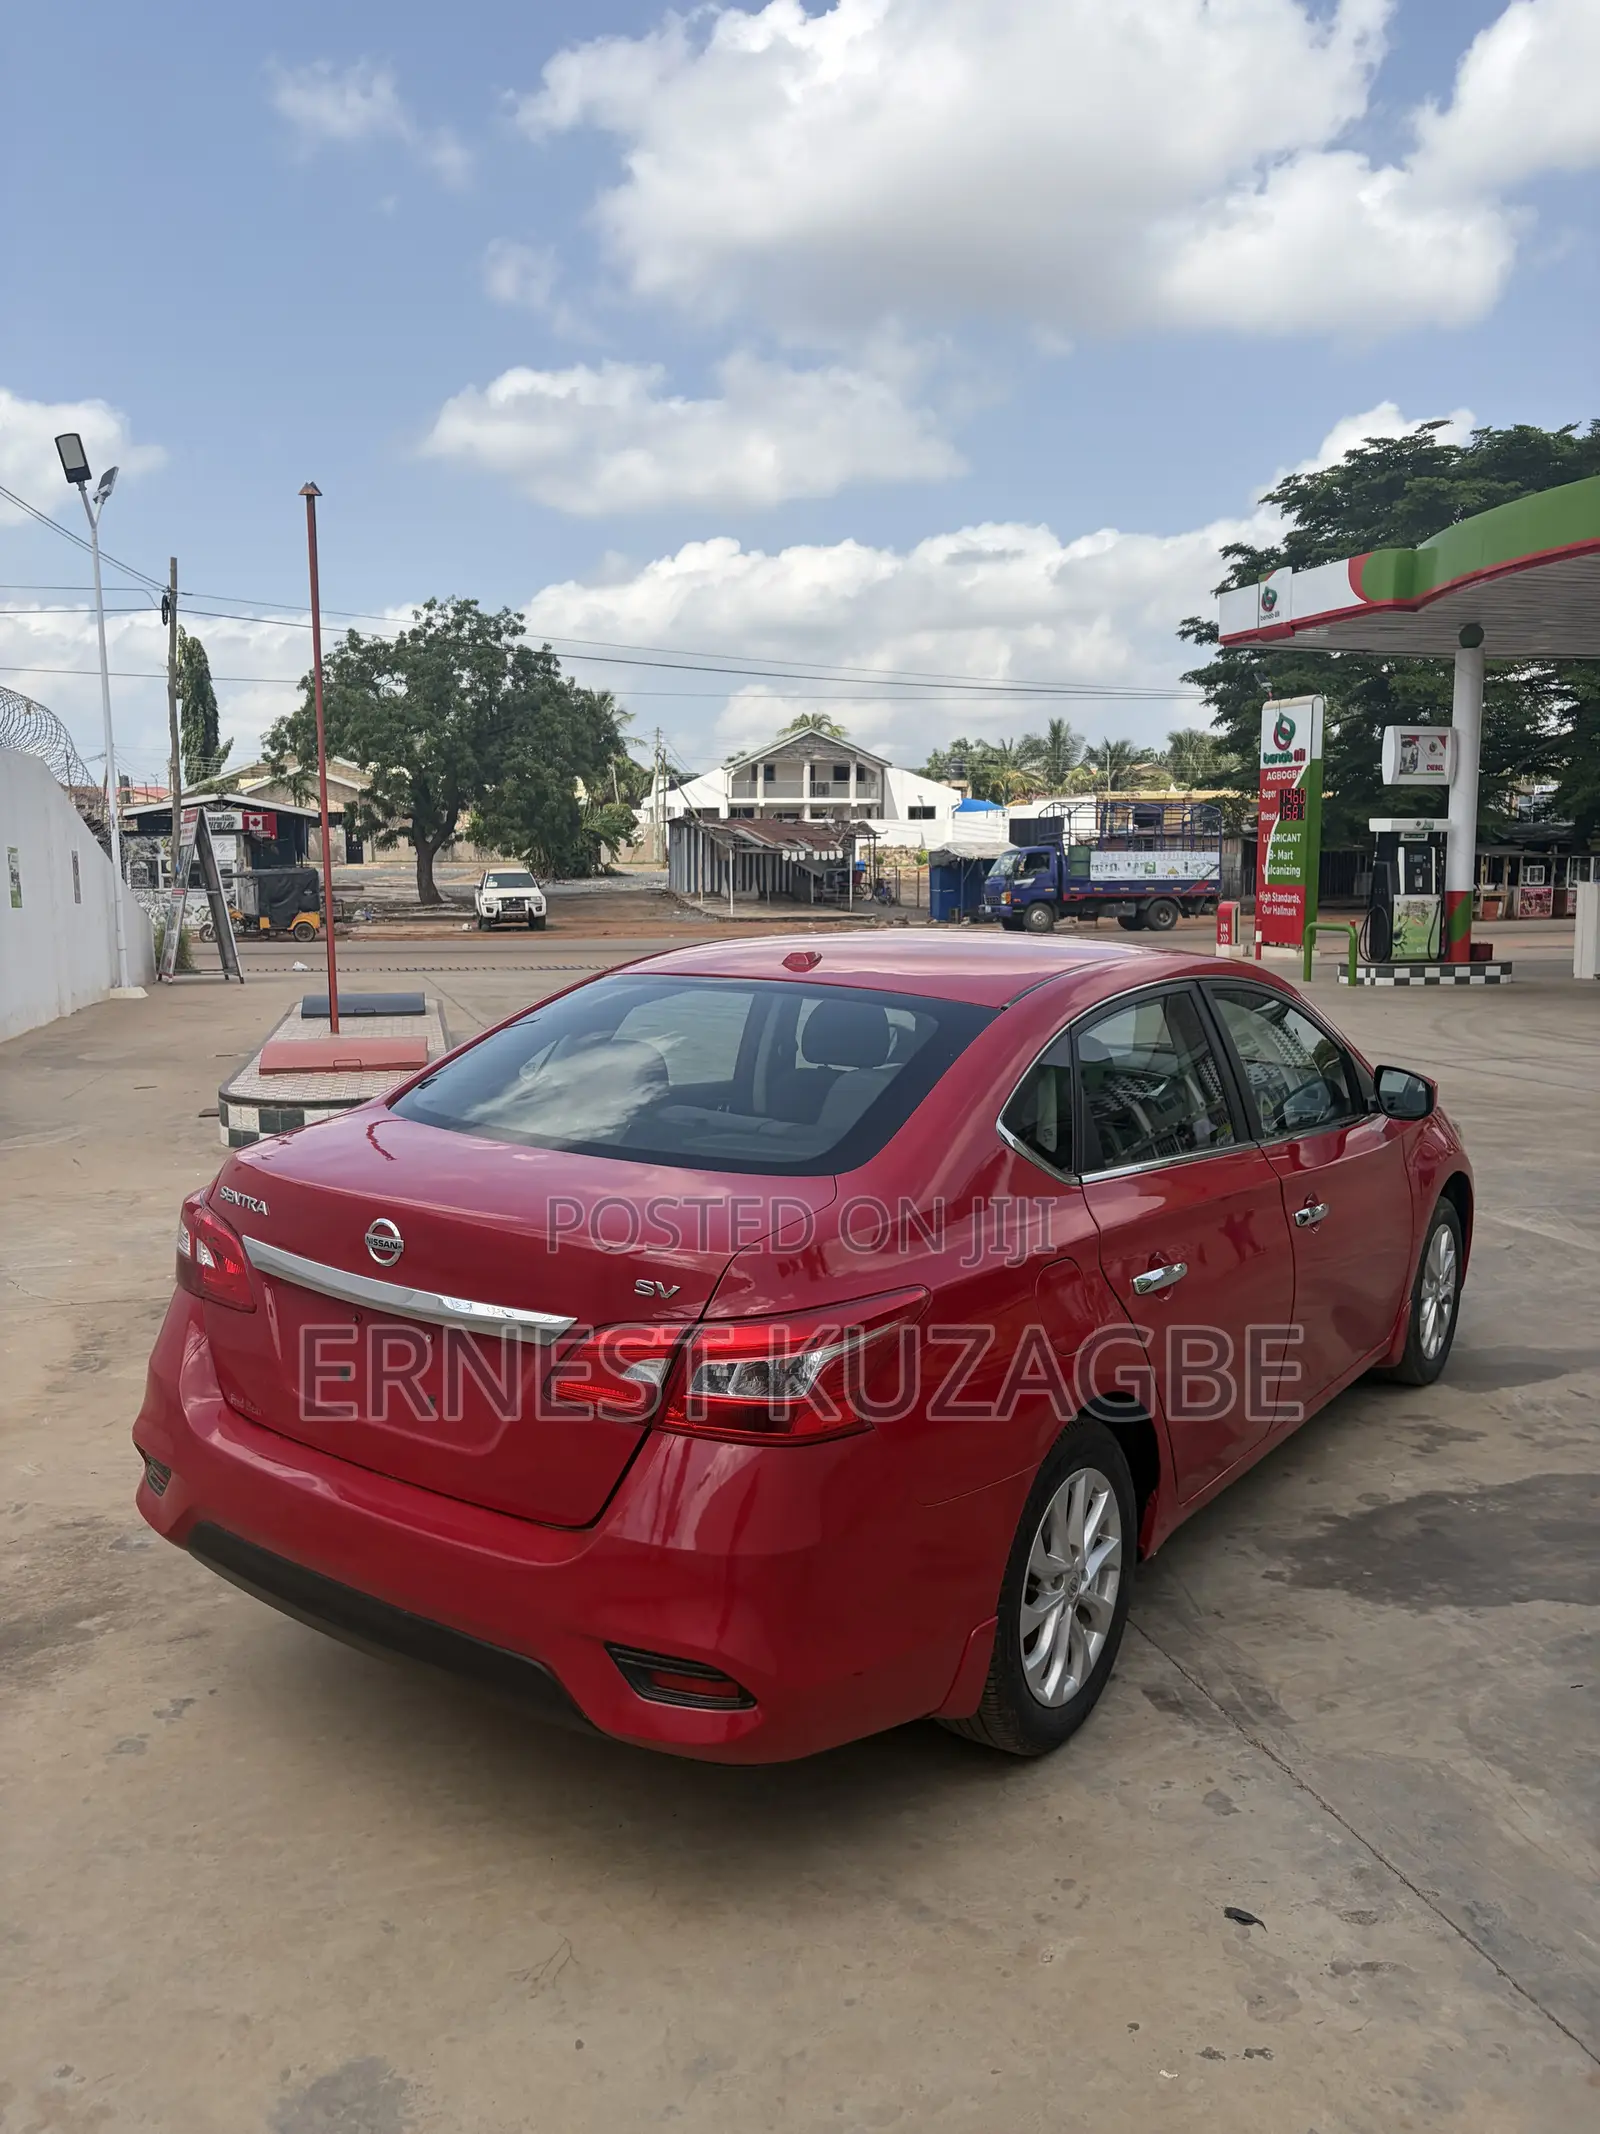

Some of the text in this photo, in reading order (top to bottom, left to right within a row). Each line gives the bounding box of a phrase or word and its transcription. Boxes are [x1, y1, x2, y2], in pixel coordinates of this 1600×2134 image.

[1262, 788, 1277, 801] Super
[1261, 811, 1277, 821] Diesel
[1263, 833, 1301, 843] LUBRICANT
[1278, 849, 1294, 861] Mart
[1261, 863, 1301, 878] Vulcanizing
[1258, 891, 1271, 904] High
[1262, 904, 1297, 916] Our Hallmark
[1220, 923, 1229, 933] IN
[219, 1185, 270, 1216] SENTRA
[366, 1235, 399, 1250] NISSAN
[633, 1278, 681, 1299] SV
